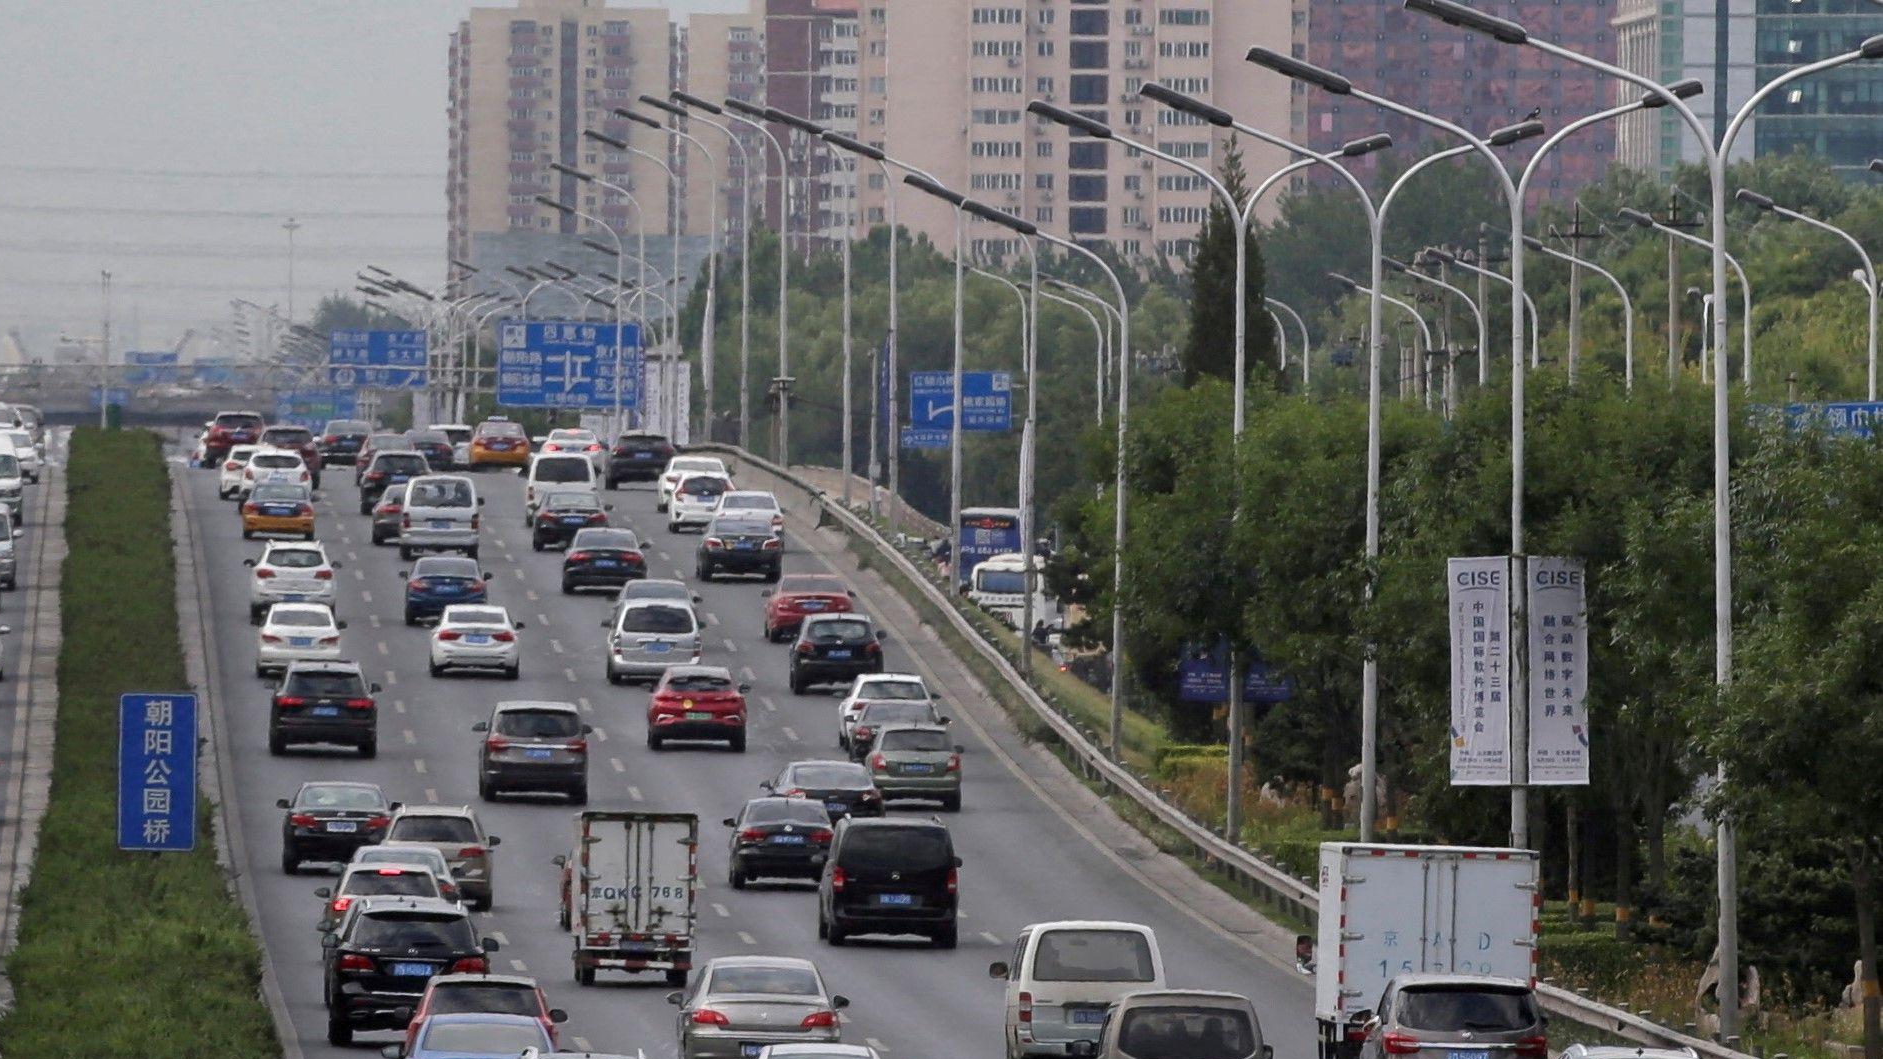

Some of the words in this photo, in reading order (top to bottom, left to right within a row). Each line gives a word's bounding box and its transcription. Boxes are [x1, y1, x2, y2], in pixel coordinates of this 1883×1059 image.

[1457, 570, 1500, 586] CISE
[1537, 570, 1580, 585] CISE
[1472, 600, 1485, 733] 中国国际软件博览会
[1490, 631, 1502, 703] 第二十三届
[143, 699, 173, 845] 朝阳公园桥
